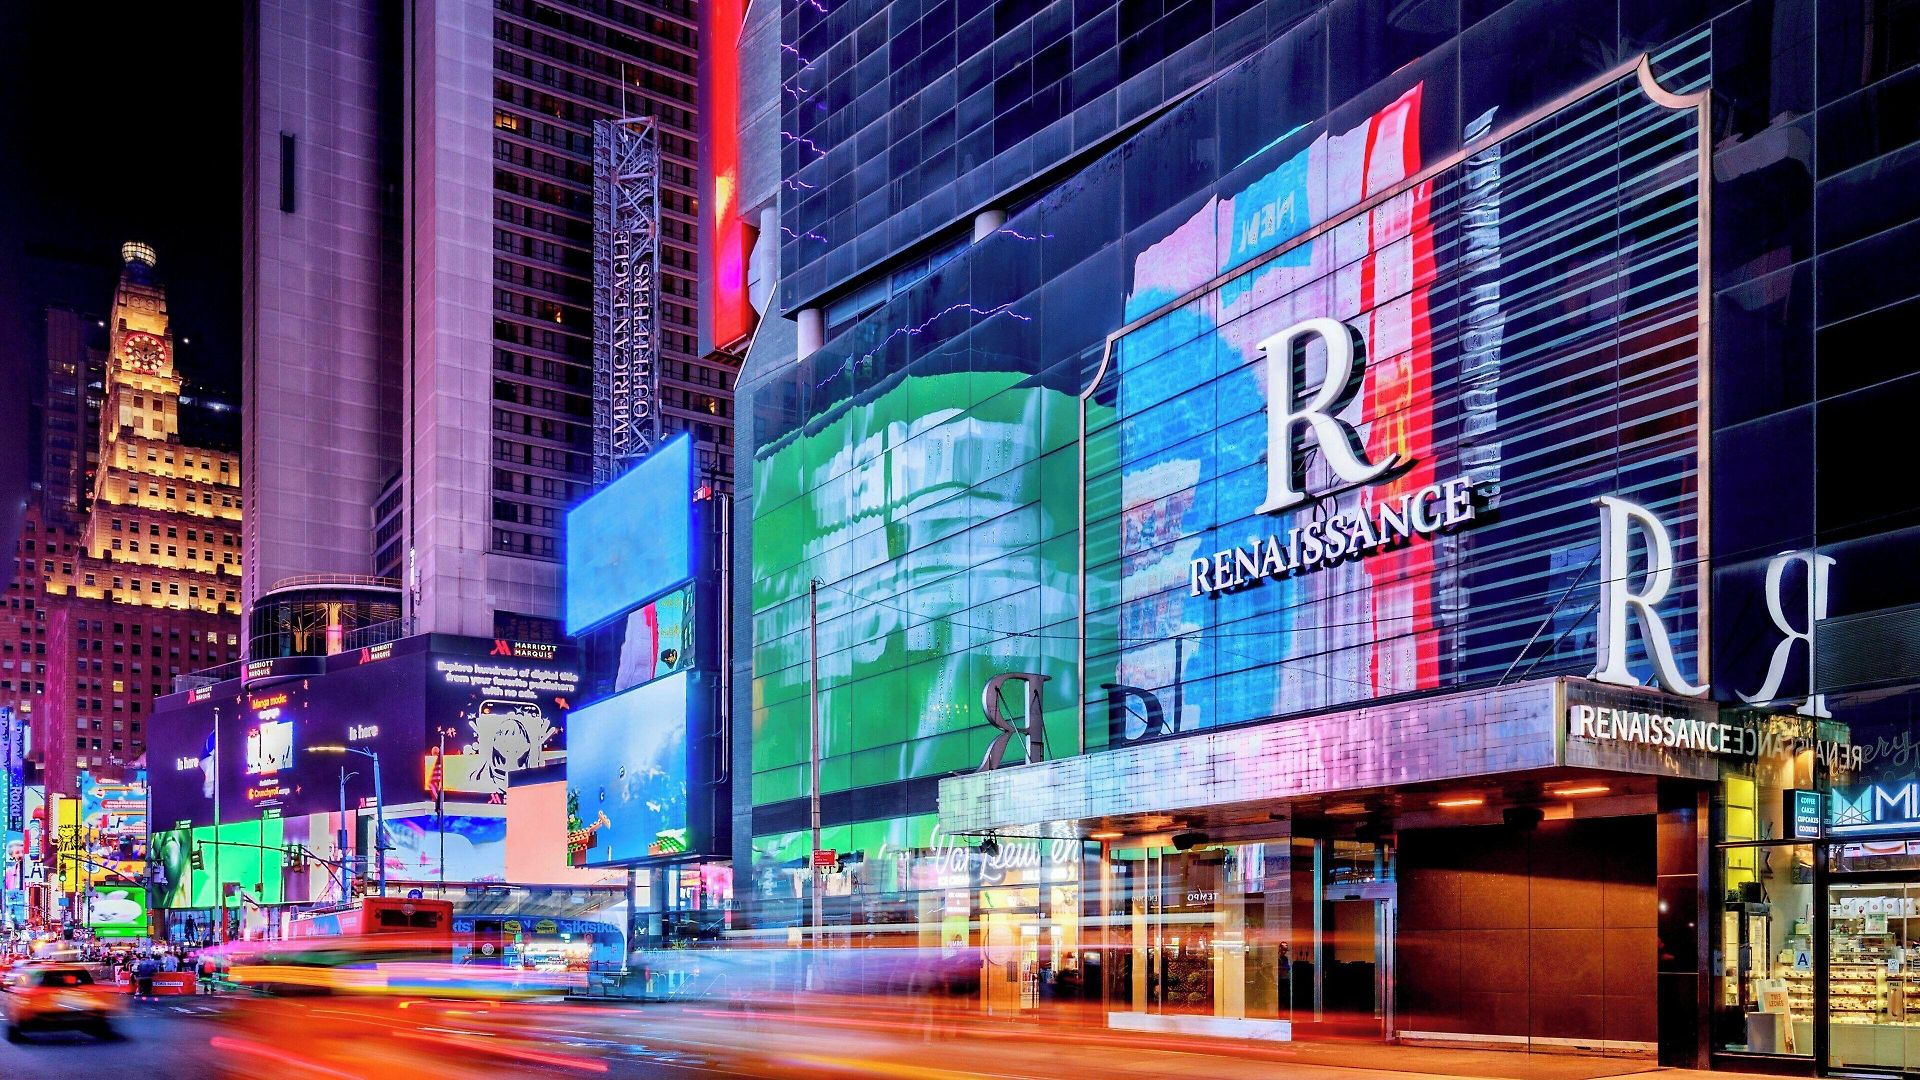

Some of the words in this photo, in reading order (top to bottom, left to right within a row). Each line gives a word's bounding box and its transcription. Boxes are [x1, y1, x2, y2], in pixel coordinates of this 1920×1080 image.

[614, 230, 630, 309] EAGLE
[633, 263, 650, 418] OUTFITTERS
[614, 318, 630, 454] AMERICAN
[1255, 317, 1399, 517] R
[1190, 475, 1476, 598] RENAISSANCE
[1588, 496, 1710, 697] R
[514, 642, 557, 652] MARRIOTT
[514, 649, 553, 659] MARQUIS
[1571, 705, 1732, 754] RENAISSANCE
[1797, 815, 1819, 824] CUPCAKES
[1801, 797, 1816, 805] COFFEE
[1875, 783, 1920, 821] MI
[1799, 825, 1818, 834] COOKIES
[1797, 952, 1809, 966] A
